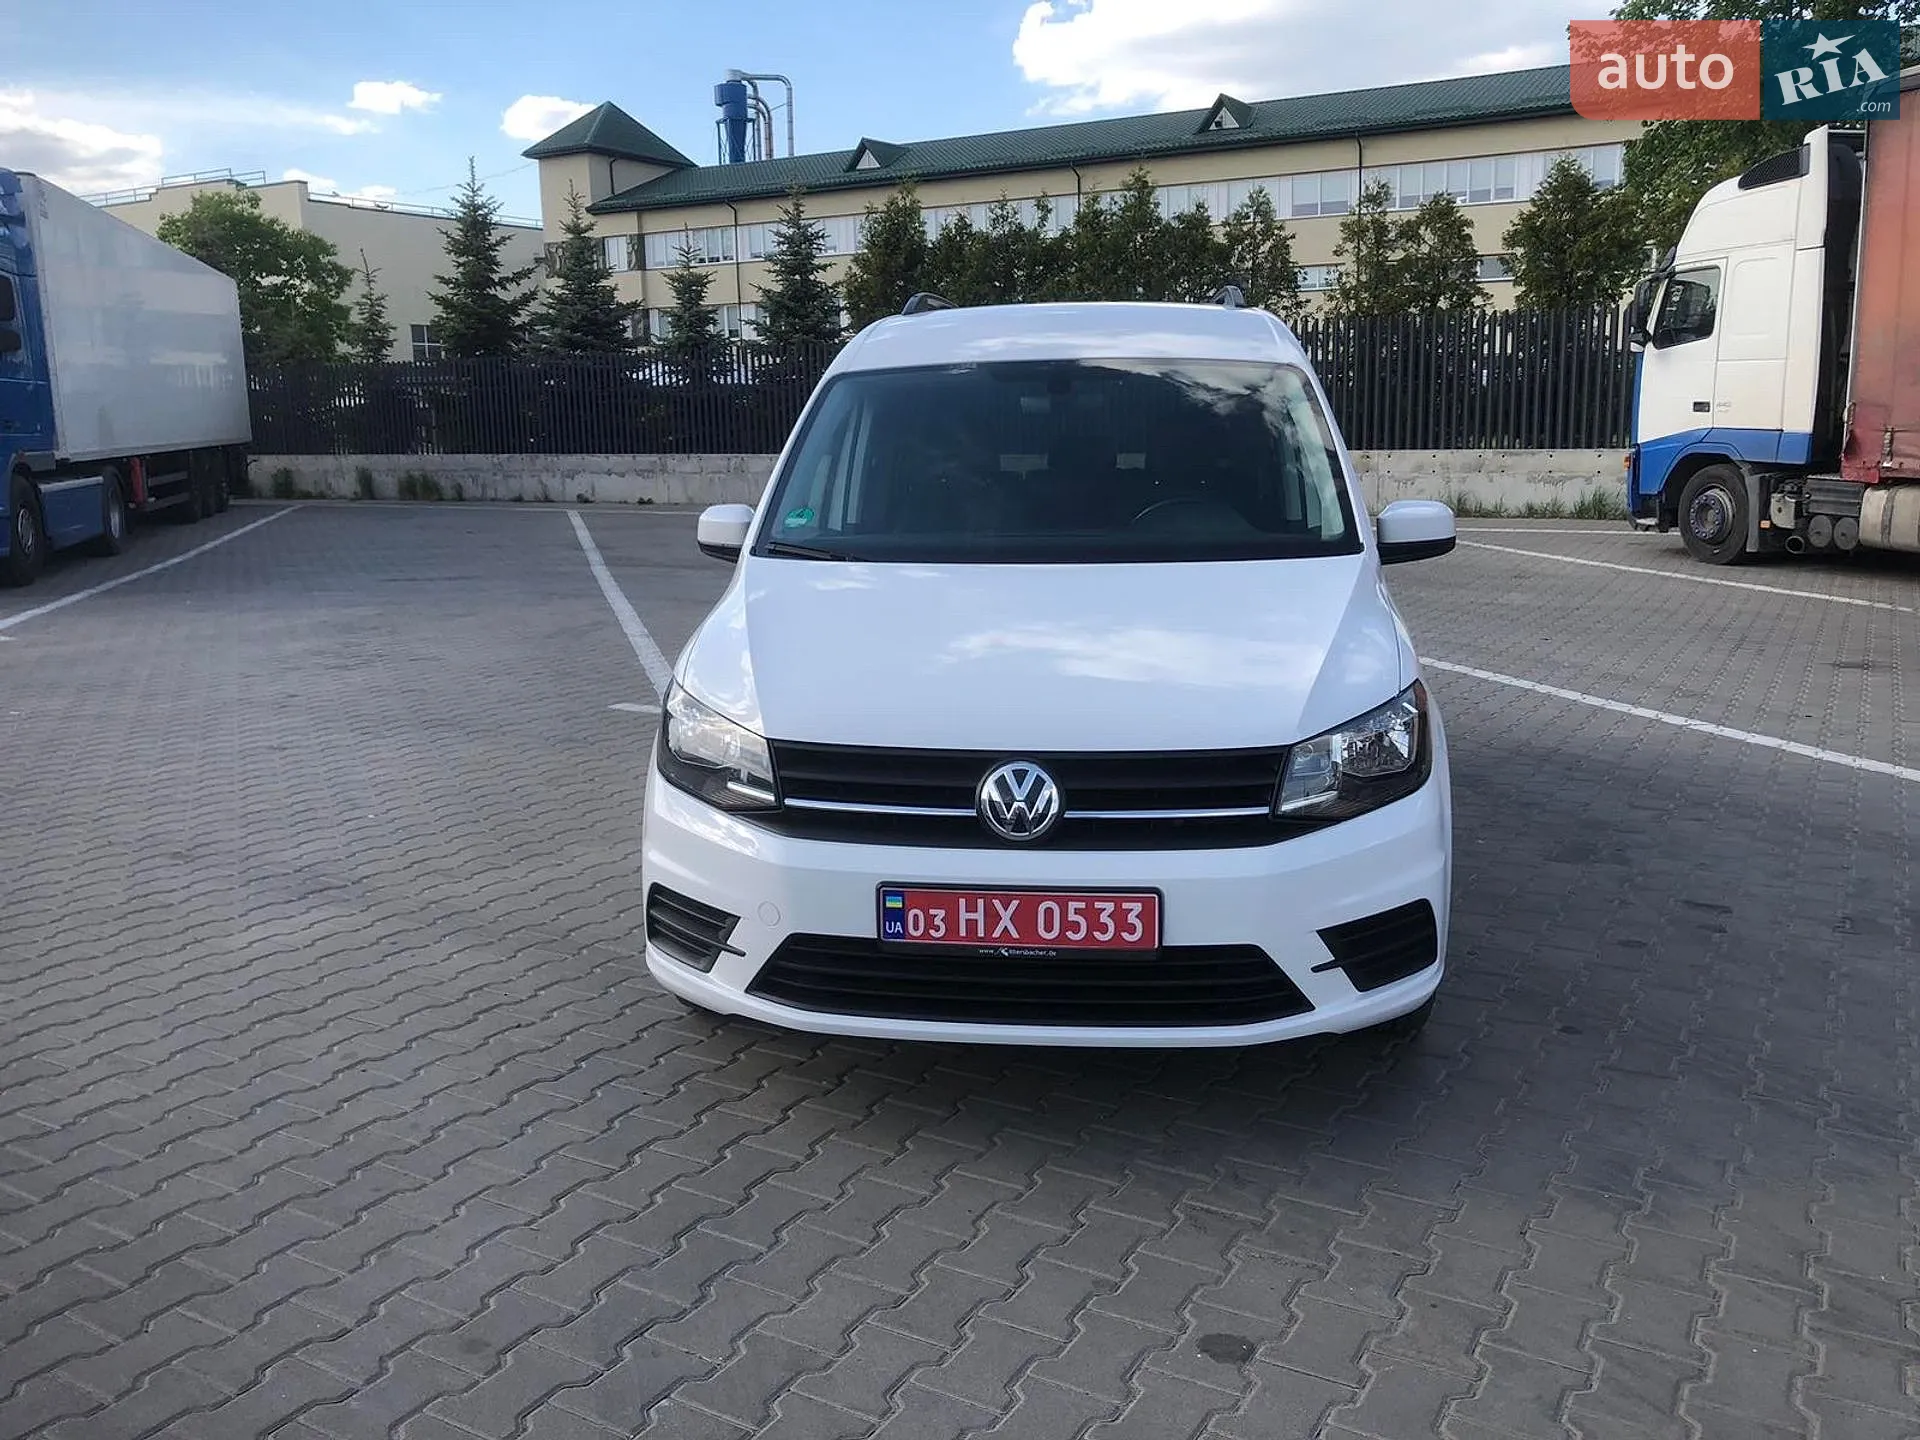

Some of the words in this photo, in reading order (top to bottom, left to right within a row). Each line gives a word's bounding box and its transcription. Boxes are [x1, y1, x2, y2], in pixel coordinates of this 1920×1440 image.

[885, 921, 903, 934] UA
[907, 908, 946, 938] 03
[958, 898, 1020, 939] HX
[1037, 900, 1143, 942] 0533
